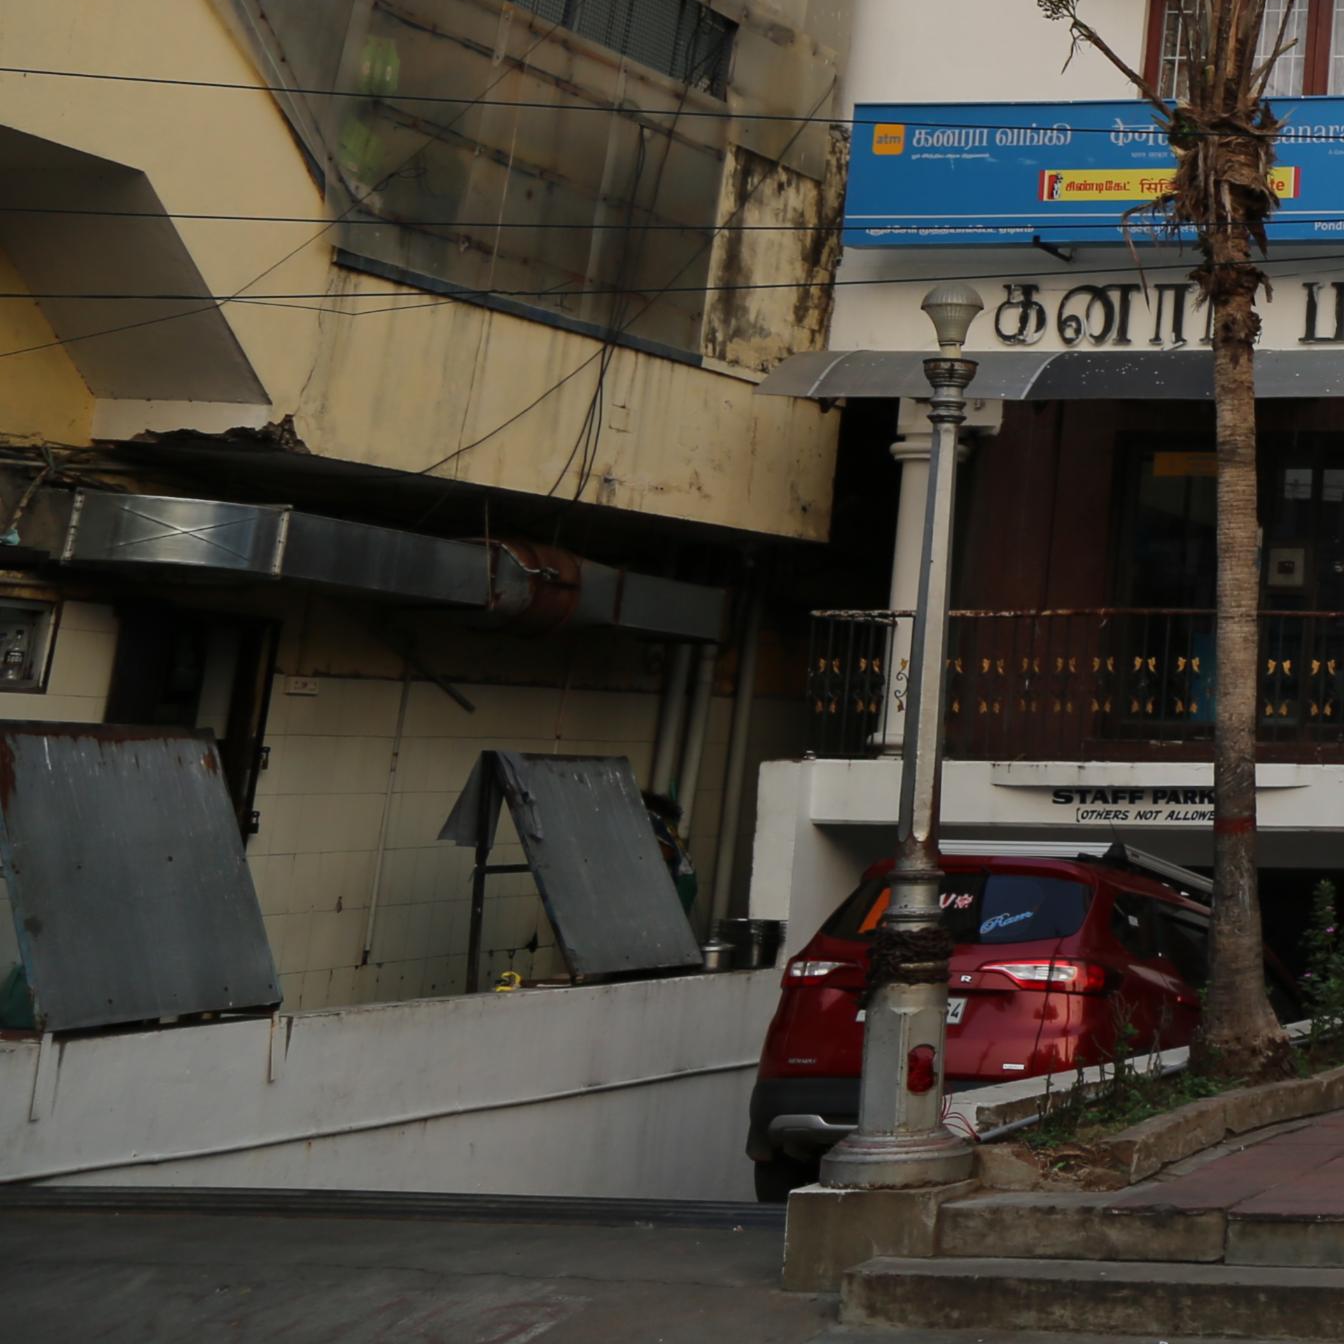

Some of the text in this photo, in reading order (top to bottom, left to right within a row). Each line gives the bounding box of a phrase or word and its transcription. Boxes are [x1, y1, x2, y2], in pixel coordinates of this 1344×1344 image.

[876, 133, 901, 144] atm
[912, 123, 1072, 150] கனரா வங்கி
[1052, 788, 1215, 805] STAFF PARK
[1134, 810, 1162, 821] NOT
[1165, 809, 1215, 822] ALLOWE
